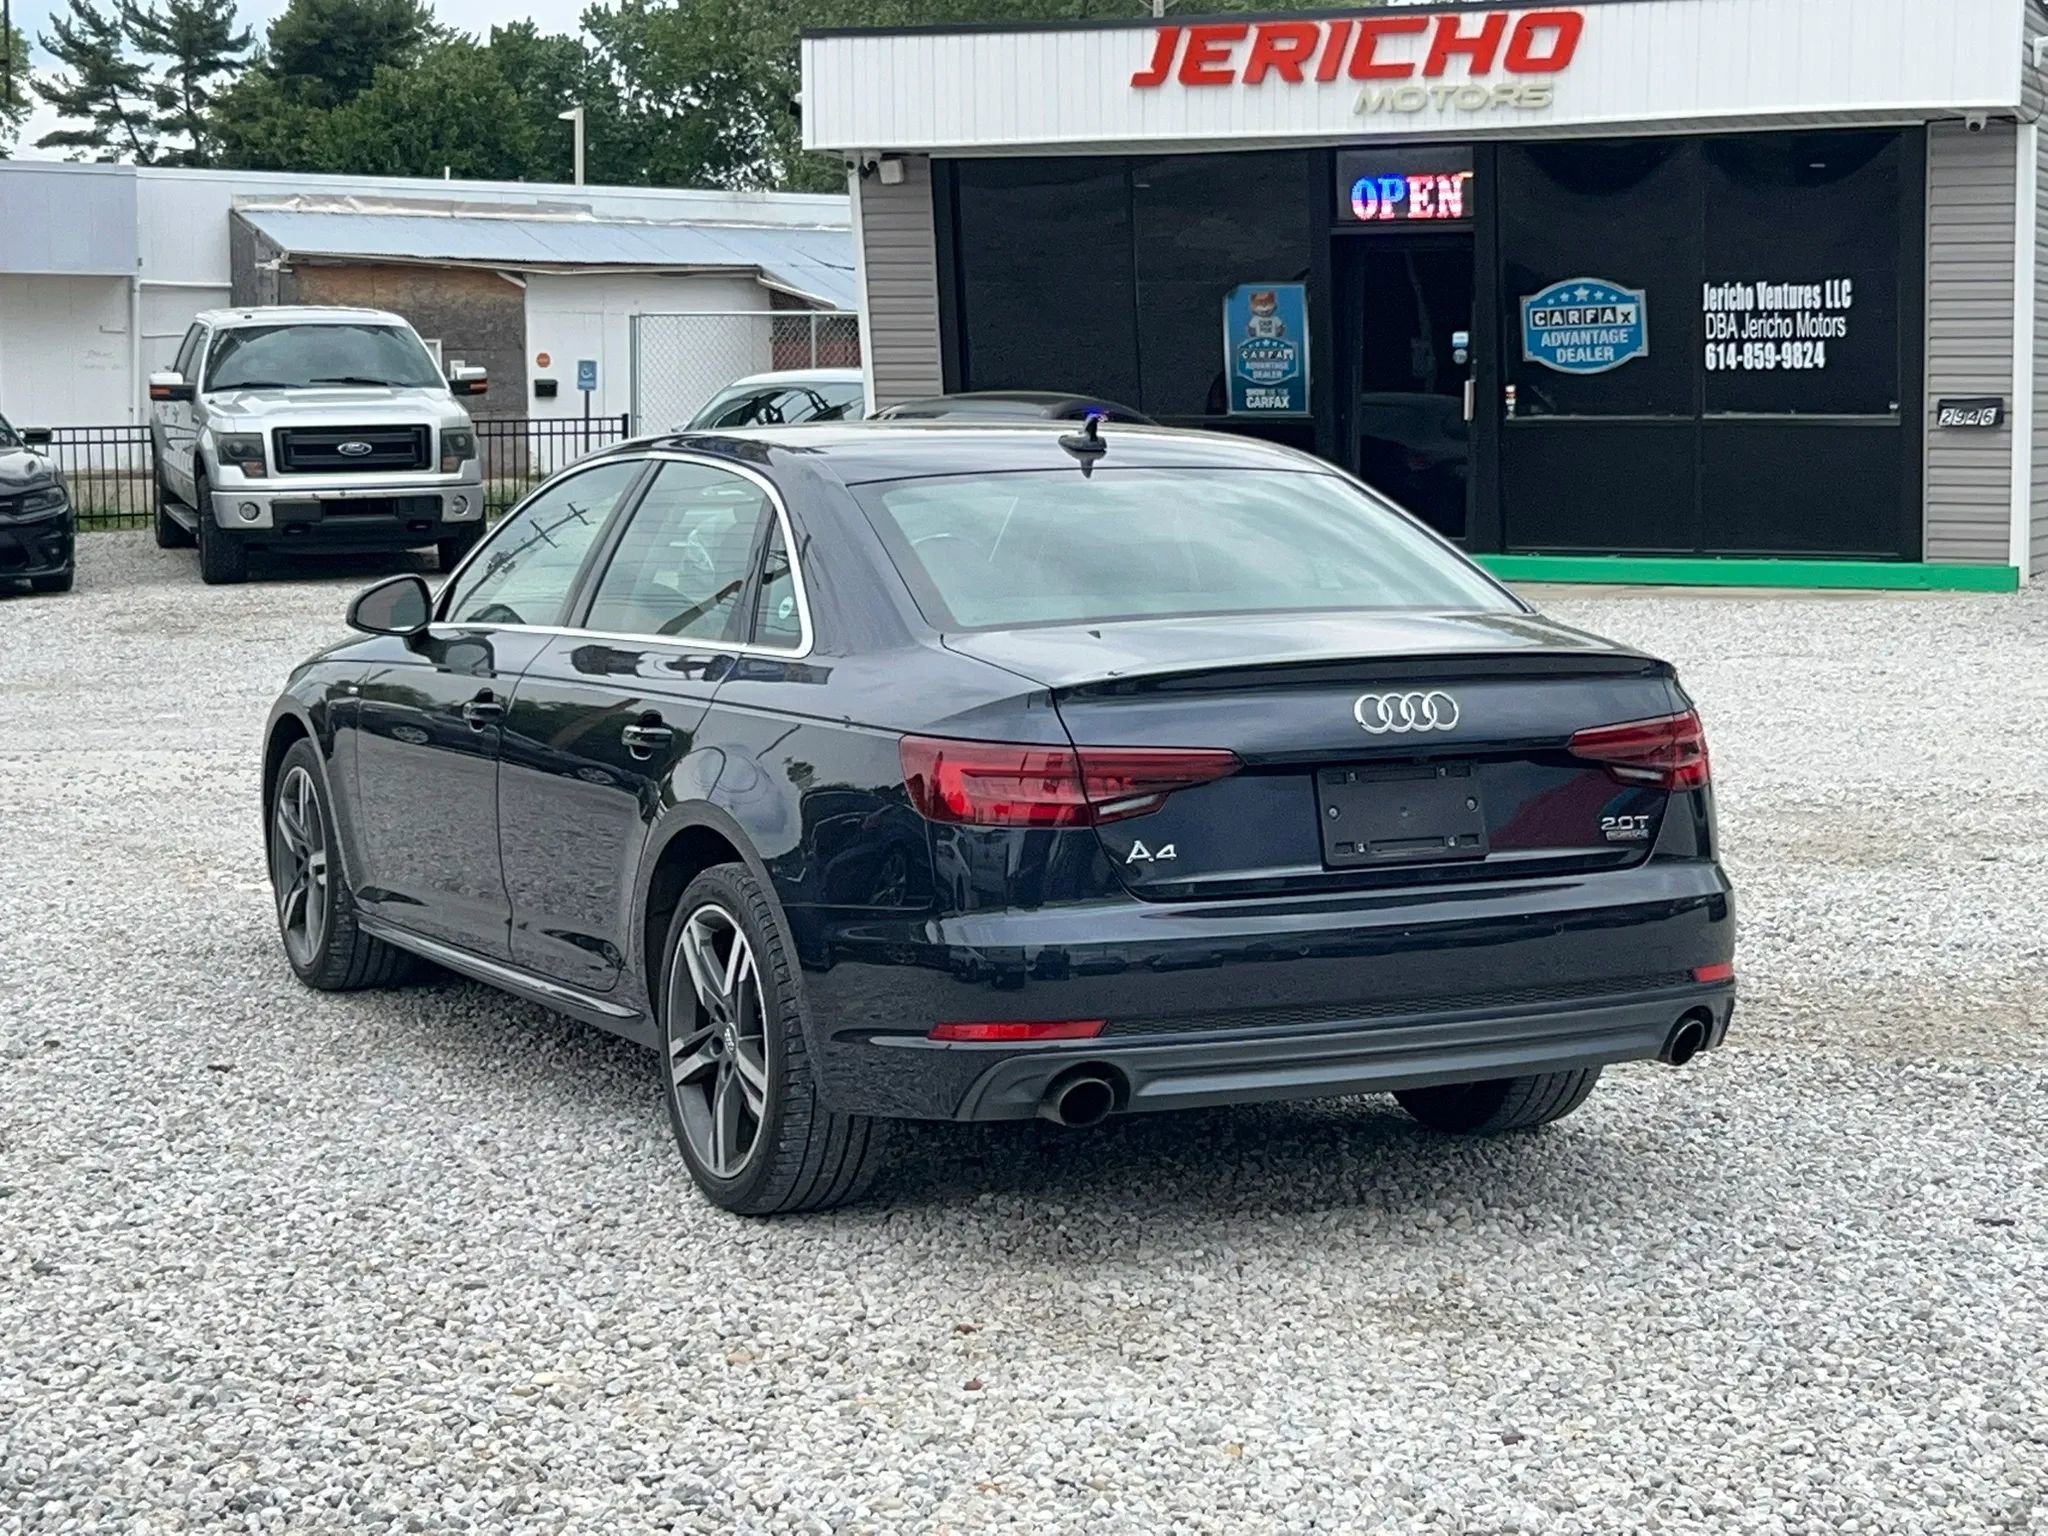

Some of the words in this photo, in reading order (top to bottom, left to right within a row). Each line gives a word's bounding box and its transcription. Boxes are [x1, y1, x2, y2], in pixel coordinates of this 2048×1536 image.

[1131, 11, 1584, 88] JERICHO
[1353, 82, 1555, 115] MOTORS
[1351, 174, 1463, 220] OPEN
[1703, 282, 1754, 311] Jericho
[1756, 281, 1821, 310] Ventures
[1825, 279, 1852, 309] LLC
[1533, 307, 1634, 326] CARFAX
[1705, 313, 1738, 339] DBA
[1741, 312, 1793, 338] Jericho
[1796, 311, 1846, 338] Motors
[1541, 329, 1629, 347] ADVANTAGE
[1556, 347, 1614, 363] DEALER
[1705, 341, 1826, 370] 614-859-9824
[1246, 396, 1289, 408] CARFAX
[1939, 408, 1996, 425] 2946
[1125, 840, 1177, 864] A4
